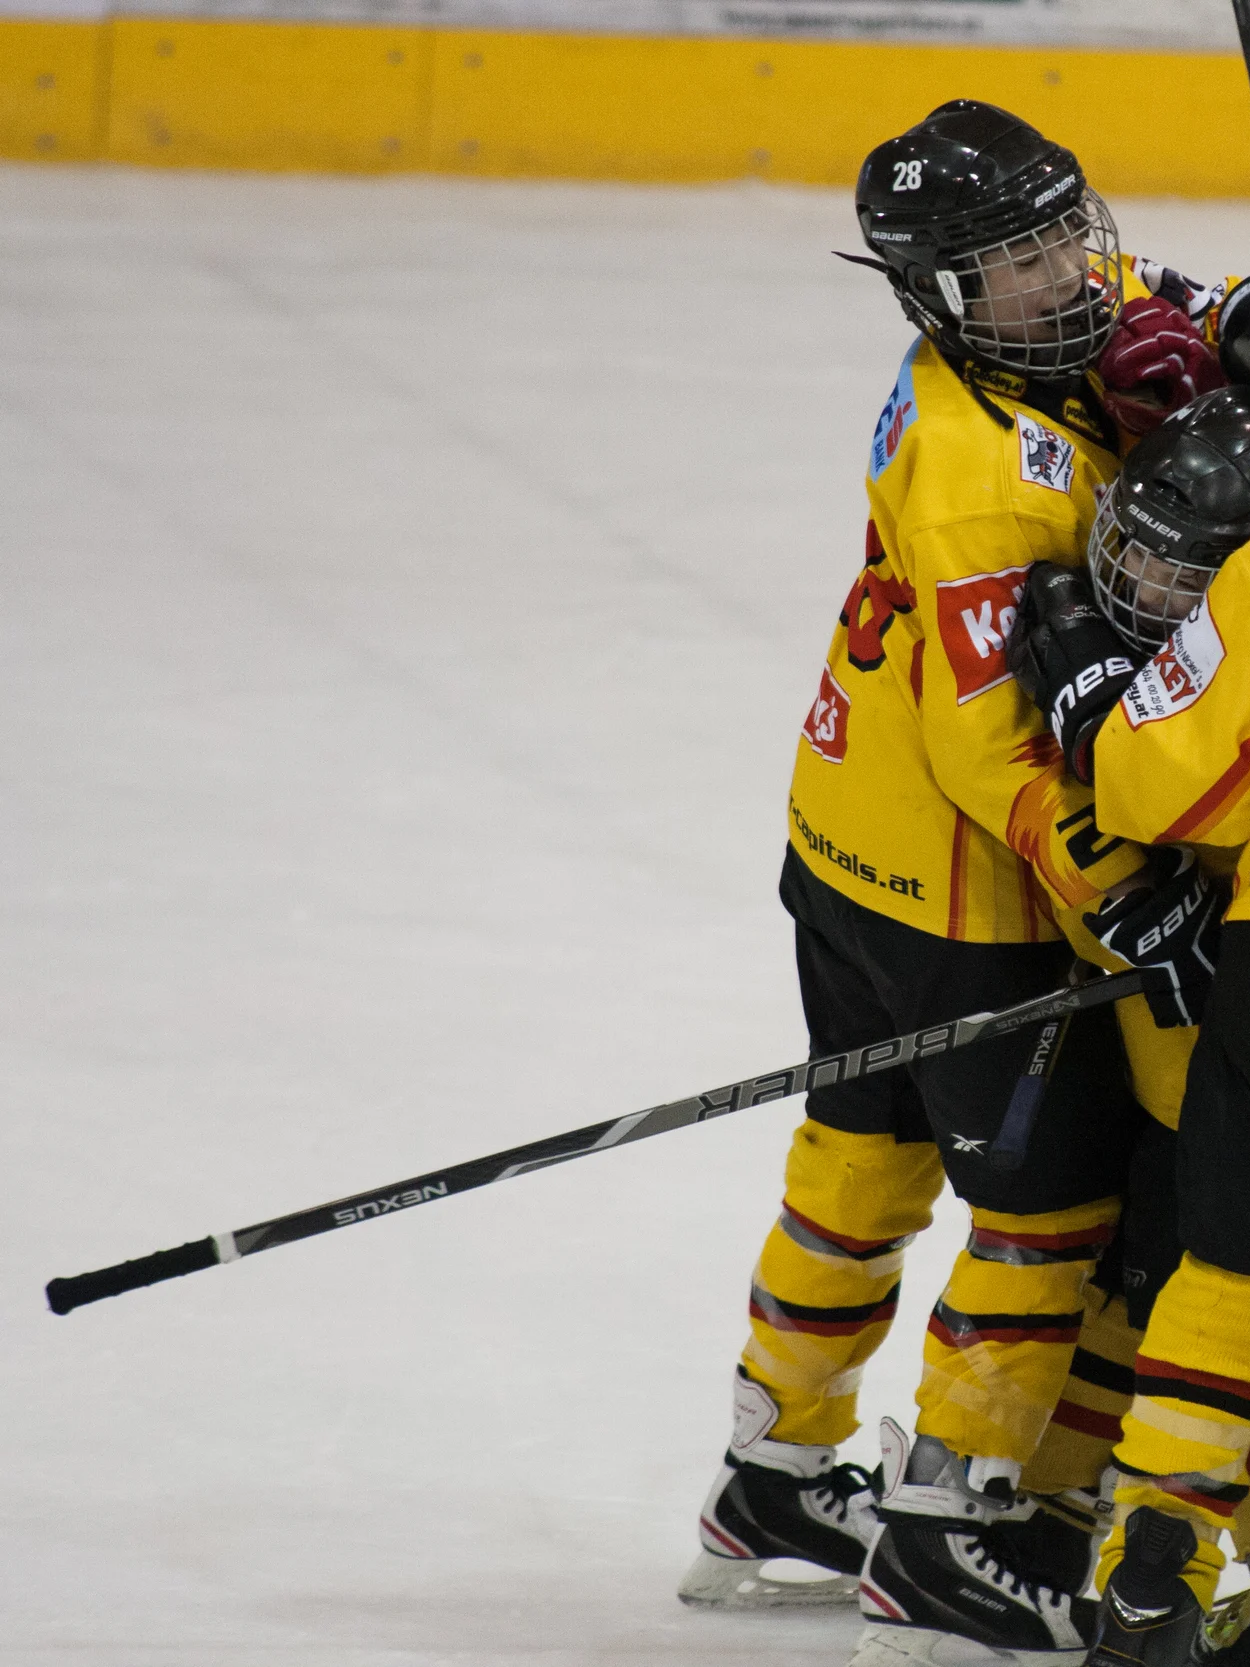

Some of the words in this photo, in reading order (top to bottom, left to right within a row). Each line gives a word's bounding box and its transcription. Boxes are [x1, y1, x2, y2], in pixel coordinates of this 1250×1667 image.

[892, 160, 923, 193] 28
[1034, 173, 1078, 209] BAUER
[870, 230, 913, 243] BAUER
[1126, 503, 1183, 542] BAUER
[788, 793, 926, 902] -capitals.at
[697, 1019, 960, 1123] BAUER
[332, 1180, 449, 1227] NEXUS
